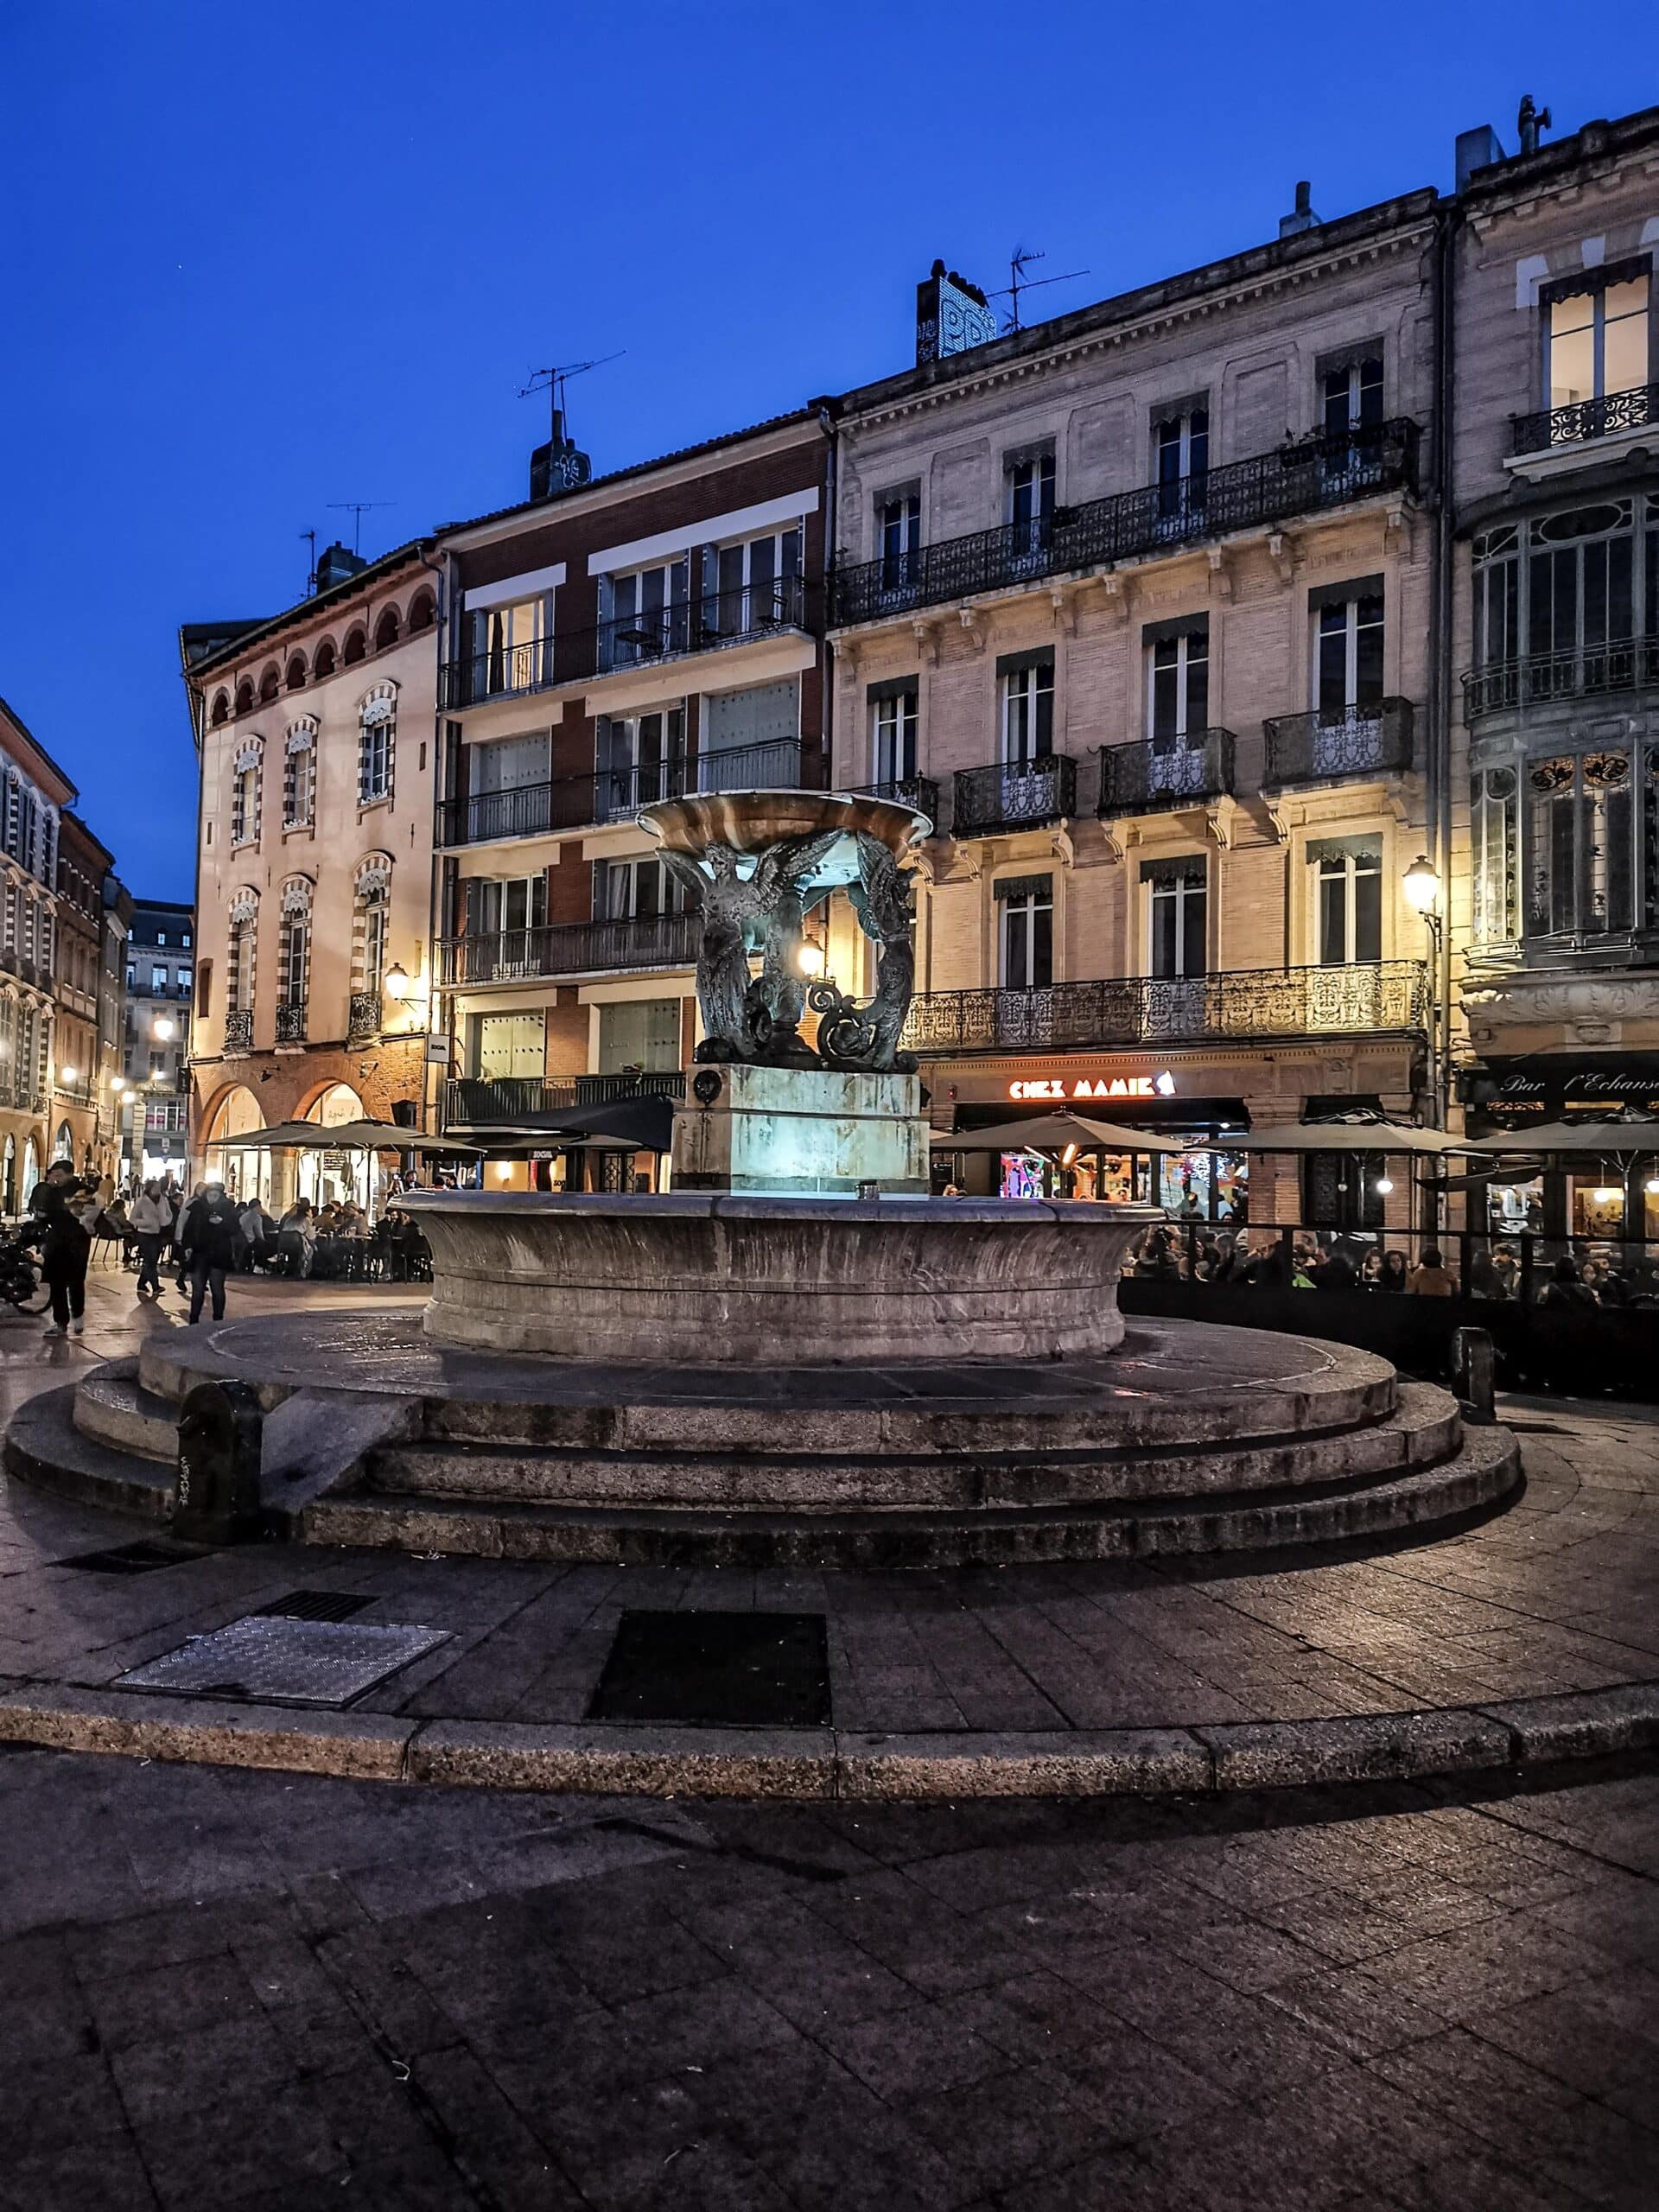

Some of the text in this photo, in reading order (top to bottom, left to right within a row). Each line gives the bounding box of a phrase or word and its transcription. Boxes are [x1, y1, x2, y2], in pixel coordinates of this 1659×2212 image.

[1009, 1077, 1155, 1099] CHEZ MAMIE
[1500, 1075, 1546, 1091] Bar
